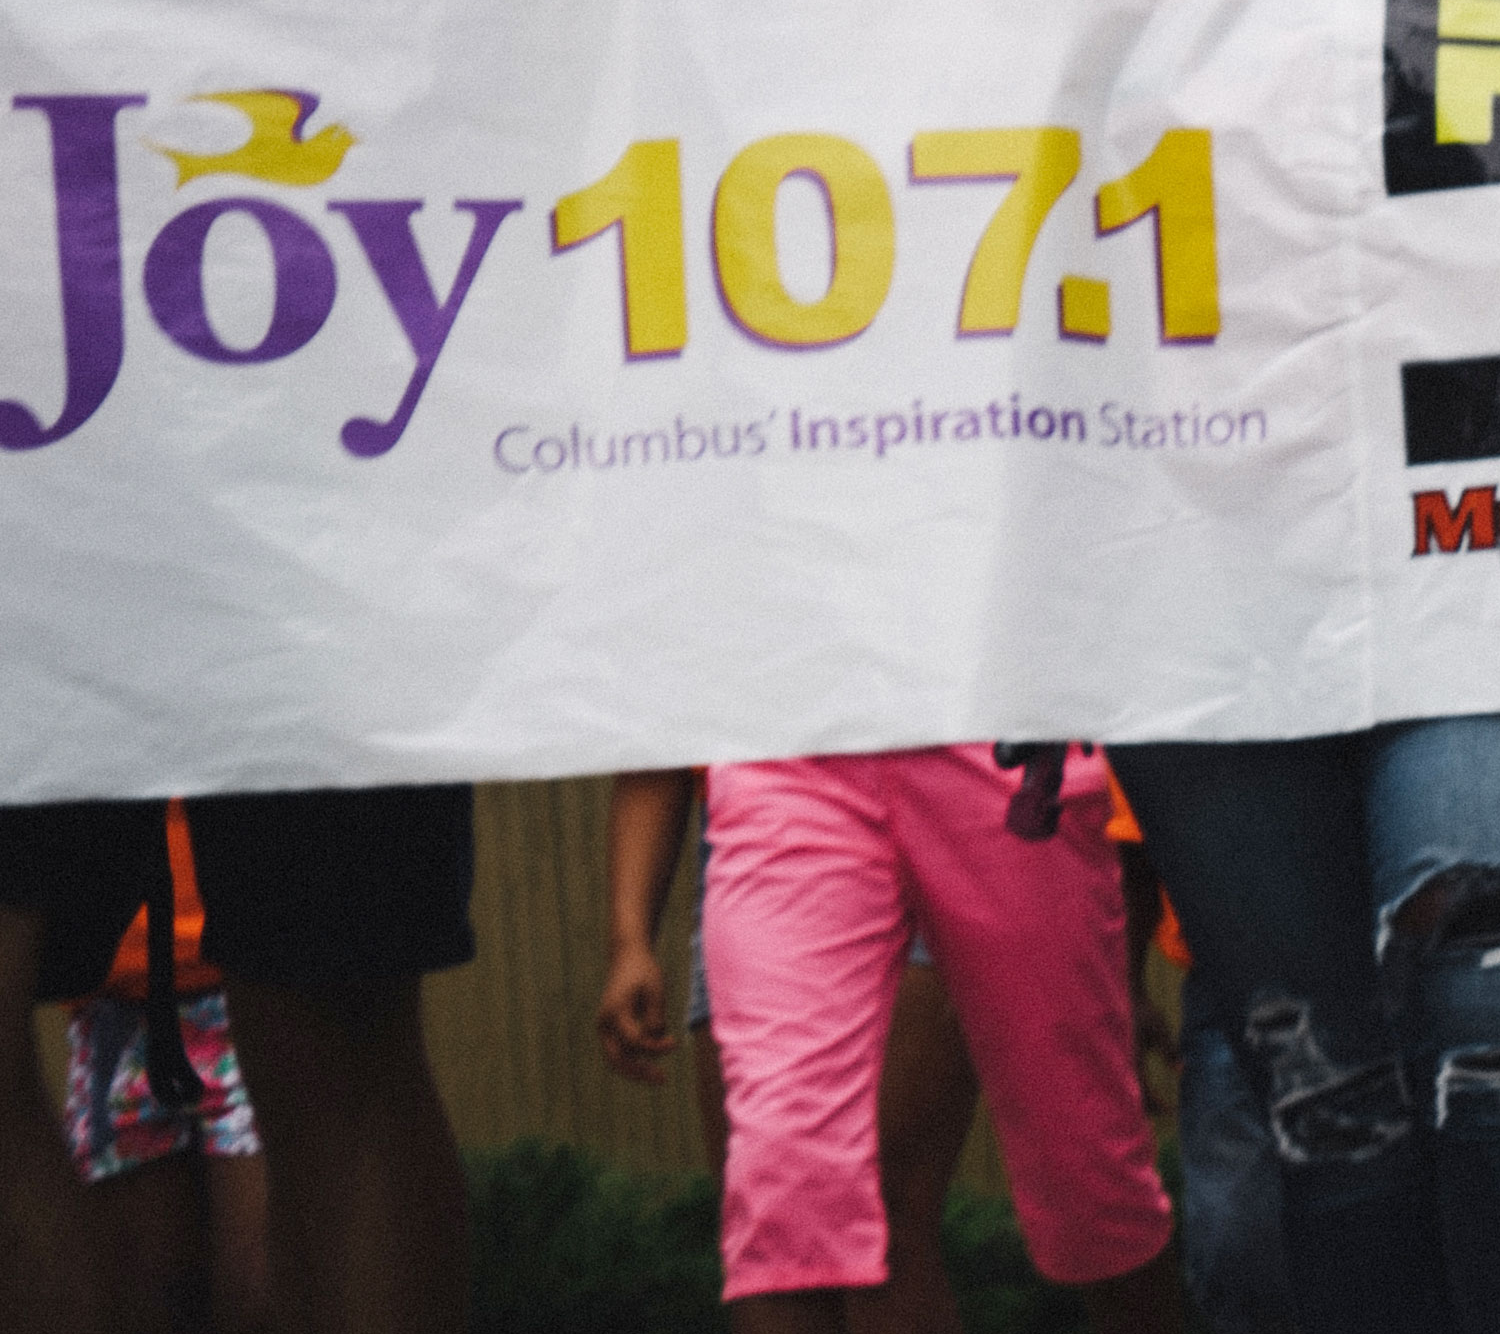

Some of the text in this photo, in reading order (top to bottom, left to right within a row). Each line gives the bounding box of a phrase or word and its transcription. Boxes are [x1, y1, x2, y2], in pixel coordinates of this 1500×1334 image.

[0, 91, 1224, 460] Joy 107.1
[788, 394, 1087, 457] Inspiration
[1096, 399, 1268, 451] Station
